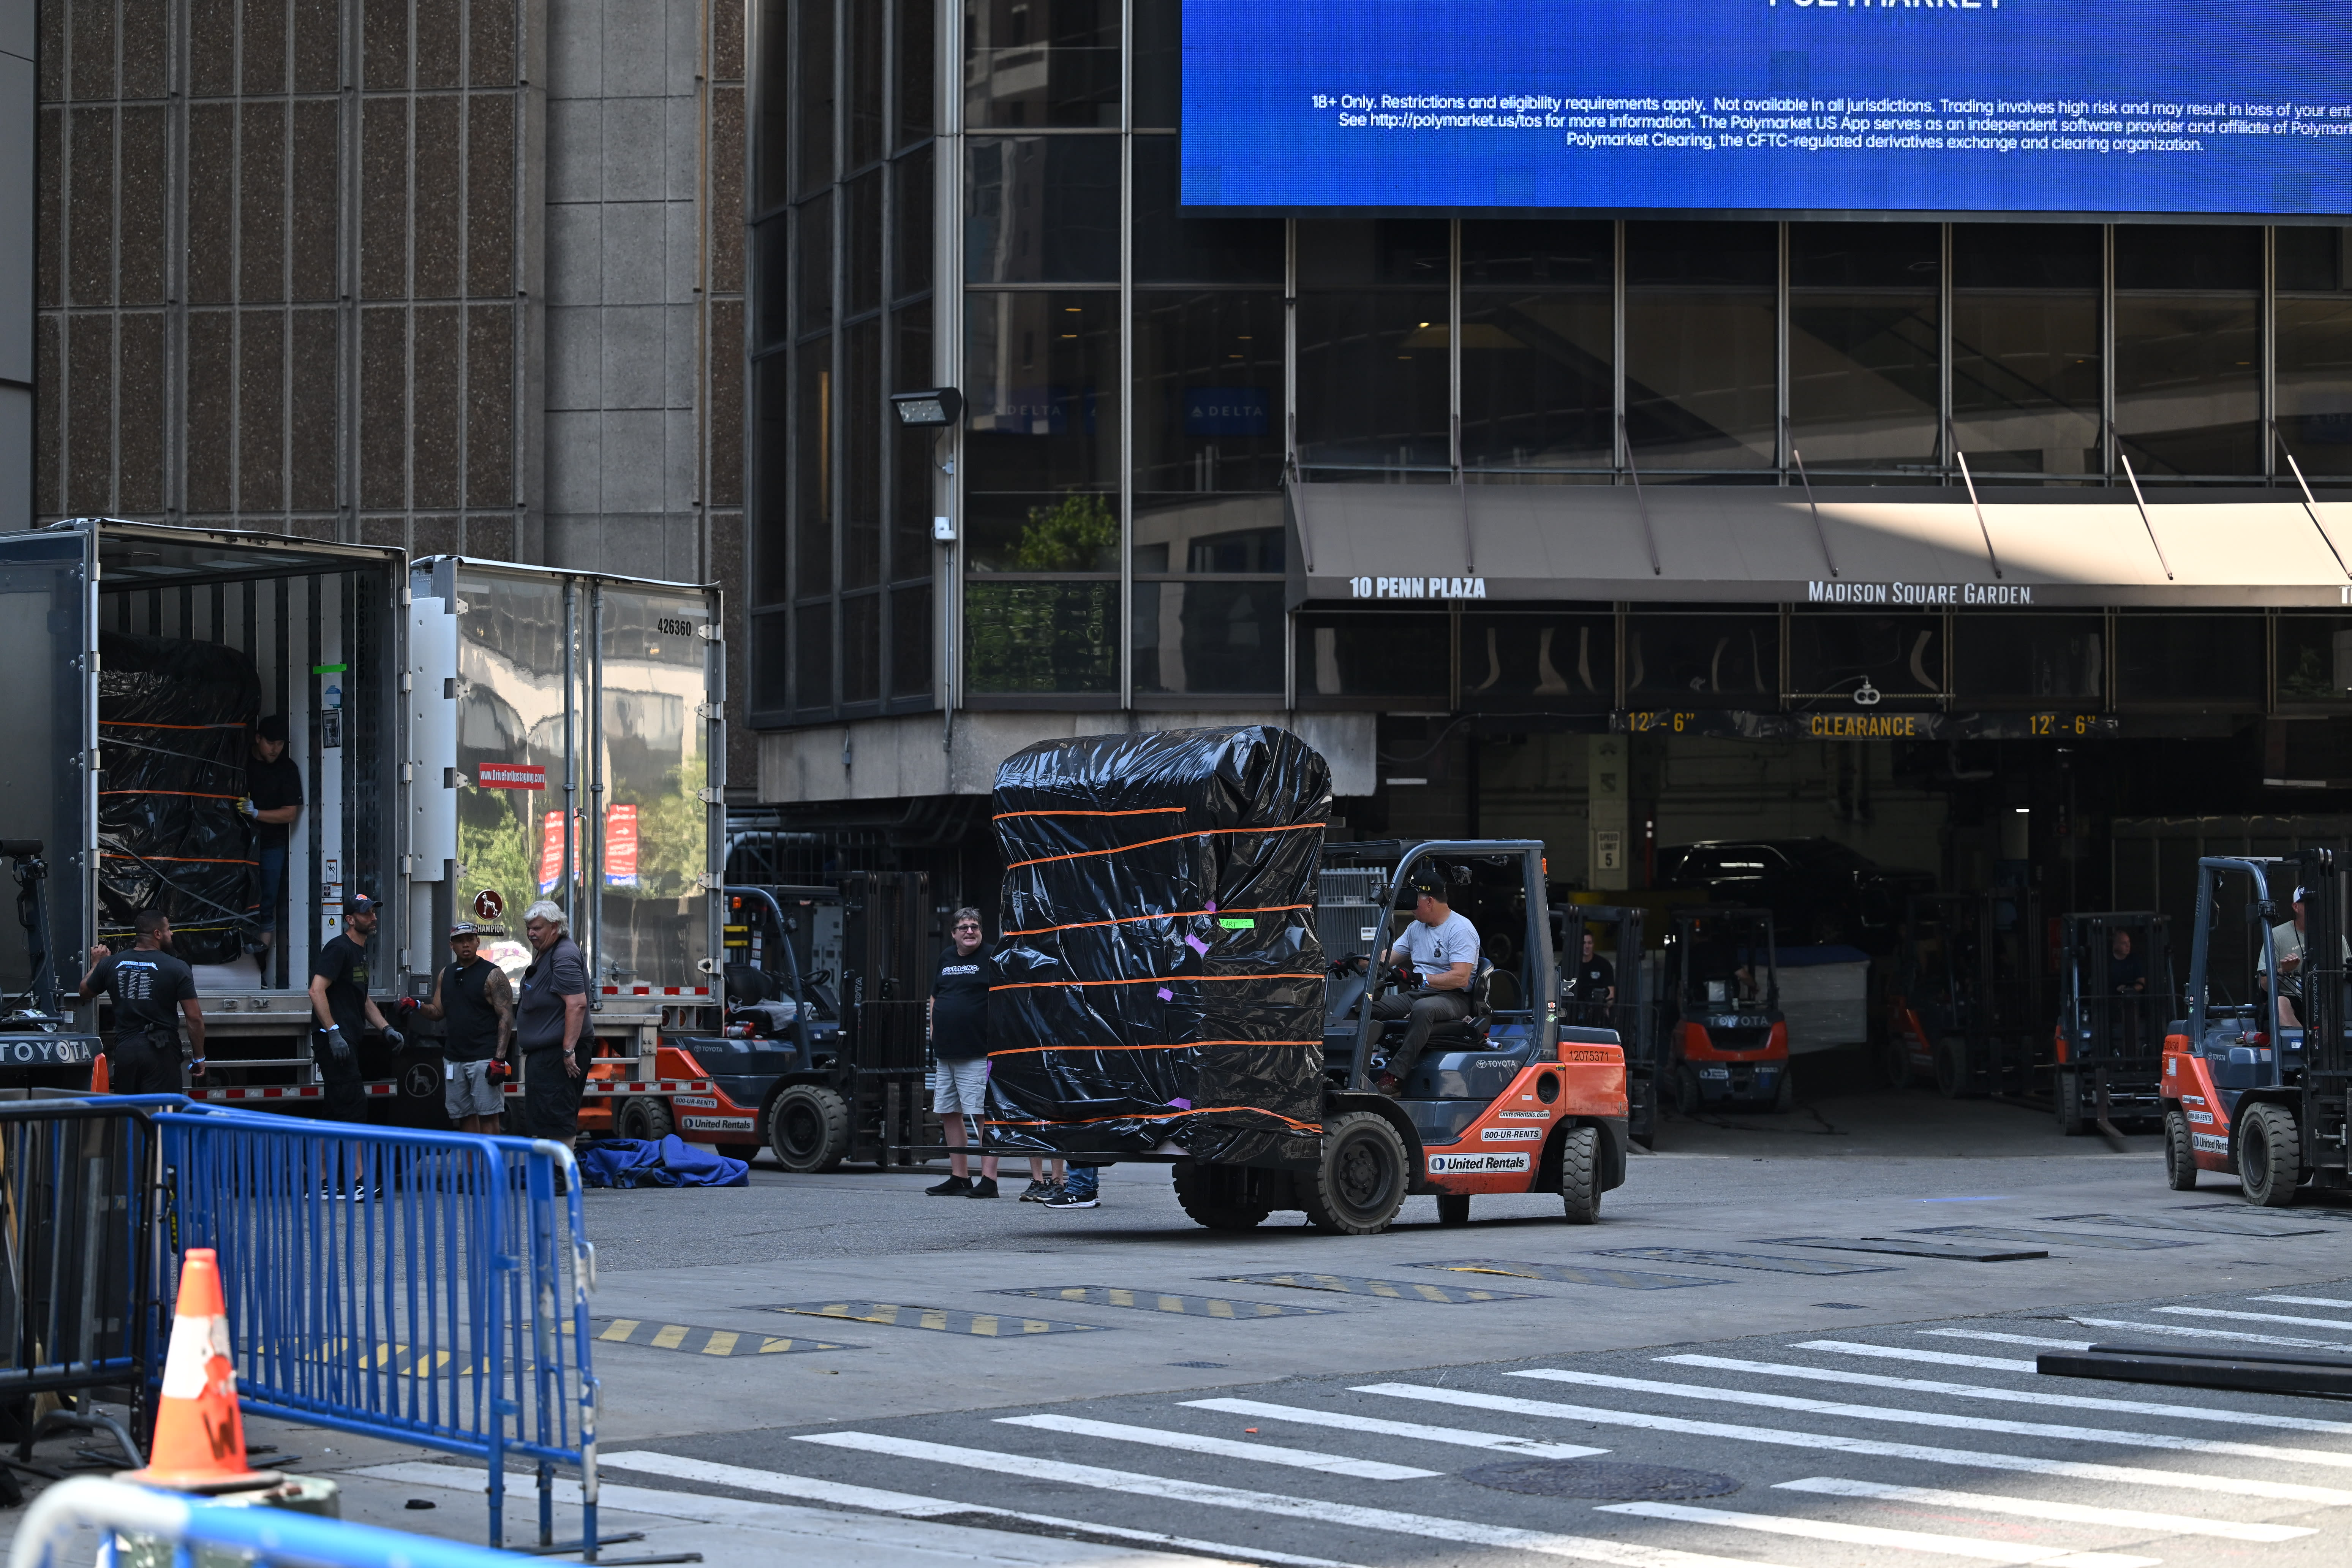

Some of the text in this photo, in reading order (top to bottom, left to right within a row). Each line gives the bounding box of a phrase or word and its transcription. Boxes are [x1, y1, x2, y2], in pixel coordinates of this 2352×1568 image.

[1313, 95, 1336, 108] 18+
[1342, 95, 1377, 111] Only.
[1382, 95, 1465, 108] Restrictions
[1468, 96, 1496, 109] and
[1500, 95, 1561, 112] eligibility
[1566, 96, 1659, 113] requirements
[1663, 97, 1706, 114] apply.
[1714, 98, 1739, 110] Not
[1743, 98, 1808, 111] available
[1812, 98, 1824, 111] in
[1827, 98, 1844, 111] all
[1846, 98, 1935, 115] jurisdictions.
[1940, 99, 1993, 116] Trading
[1998, 100, 2055, 113] involves
[2058, 100, 2088, 117] high
[2093, 100, 2117, 114] risk
[2121, 102, 2148, 114] and
[2153, 104, 2183, 117] may
[2187, 103, 2226, 115] result
[2230, 102, 2241, 115] in
[2246, 103, 2273, 115] loss
[2276, 103, 2290, 116] of
[2295, 106, 2325, 120] your
[1339, 113, 1367, 126] See
[1545, 113, 1565, 127] for
[1569, 117, 1606, 127] more
[1610, 114, 1694, 128] information.
[1700, 115, 1727, 128] The
[1731, 115, 1812, 132] Polymarket
[1816, 116, 1837, 130] US
[1841, 117, 1870, 132] App
[1874, 119, 1922, 130] serves
[1925, 120, 1943, 130] as
[1946, 120, 1964, 130] an
[1968, 118, 2057, 134] independent
[2061, 118, 2123, 132] software
[2126, 119, 2184, 135] provider
[2188, 121, 2215, 133] and
[2219, 120, 2270, 133] affiliate
[2273, 120, 2287, 134] of
[1567, 132, 2203, 153] Polymarket Clearing, the CFTC-regulated derivatives exchange and clearing organization.
[1209, 406, 1264, 417] DELTA
[1350, 577, 1486, 598] 10 PENN PLAZA
[1808, 581, 1886, 602] MADISON
[1892, 582, 1957, 605] SQUARE
[657, 618, 692, 637] 426360
[1811, 716, 1915, 737] CLEARANCE
[480, 768, 545, 783] www.DriveForUpstaging.com
[1606, 853, 1612, 867] 5
[1707, 1015, 1769, 1027] TOYOTA
[1569, 1050, 1609, 1061] 12075371
[675, 1097, 715, 1106] 800-UR-RENTS
[695, 1119, 751, 1129] United Rentals
[2188, 1113, 2211, 1122] 800-UR-RENTS
[1484, 1130, 1539, 1139] 800-UR-RENTS
[2200, 1138, 2229, 1151] United Renta
[1448, 1156, 1525, 1170] United Rentals
